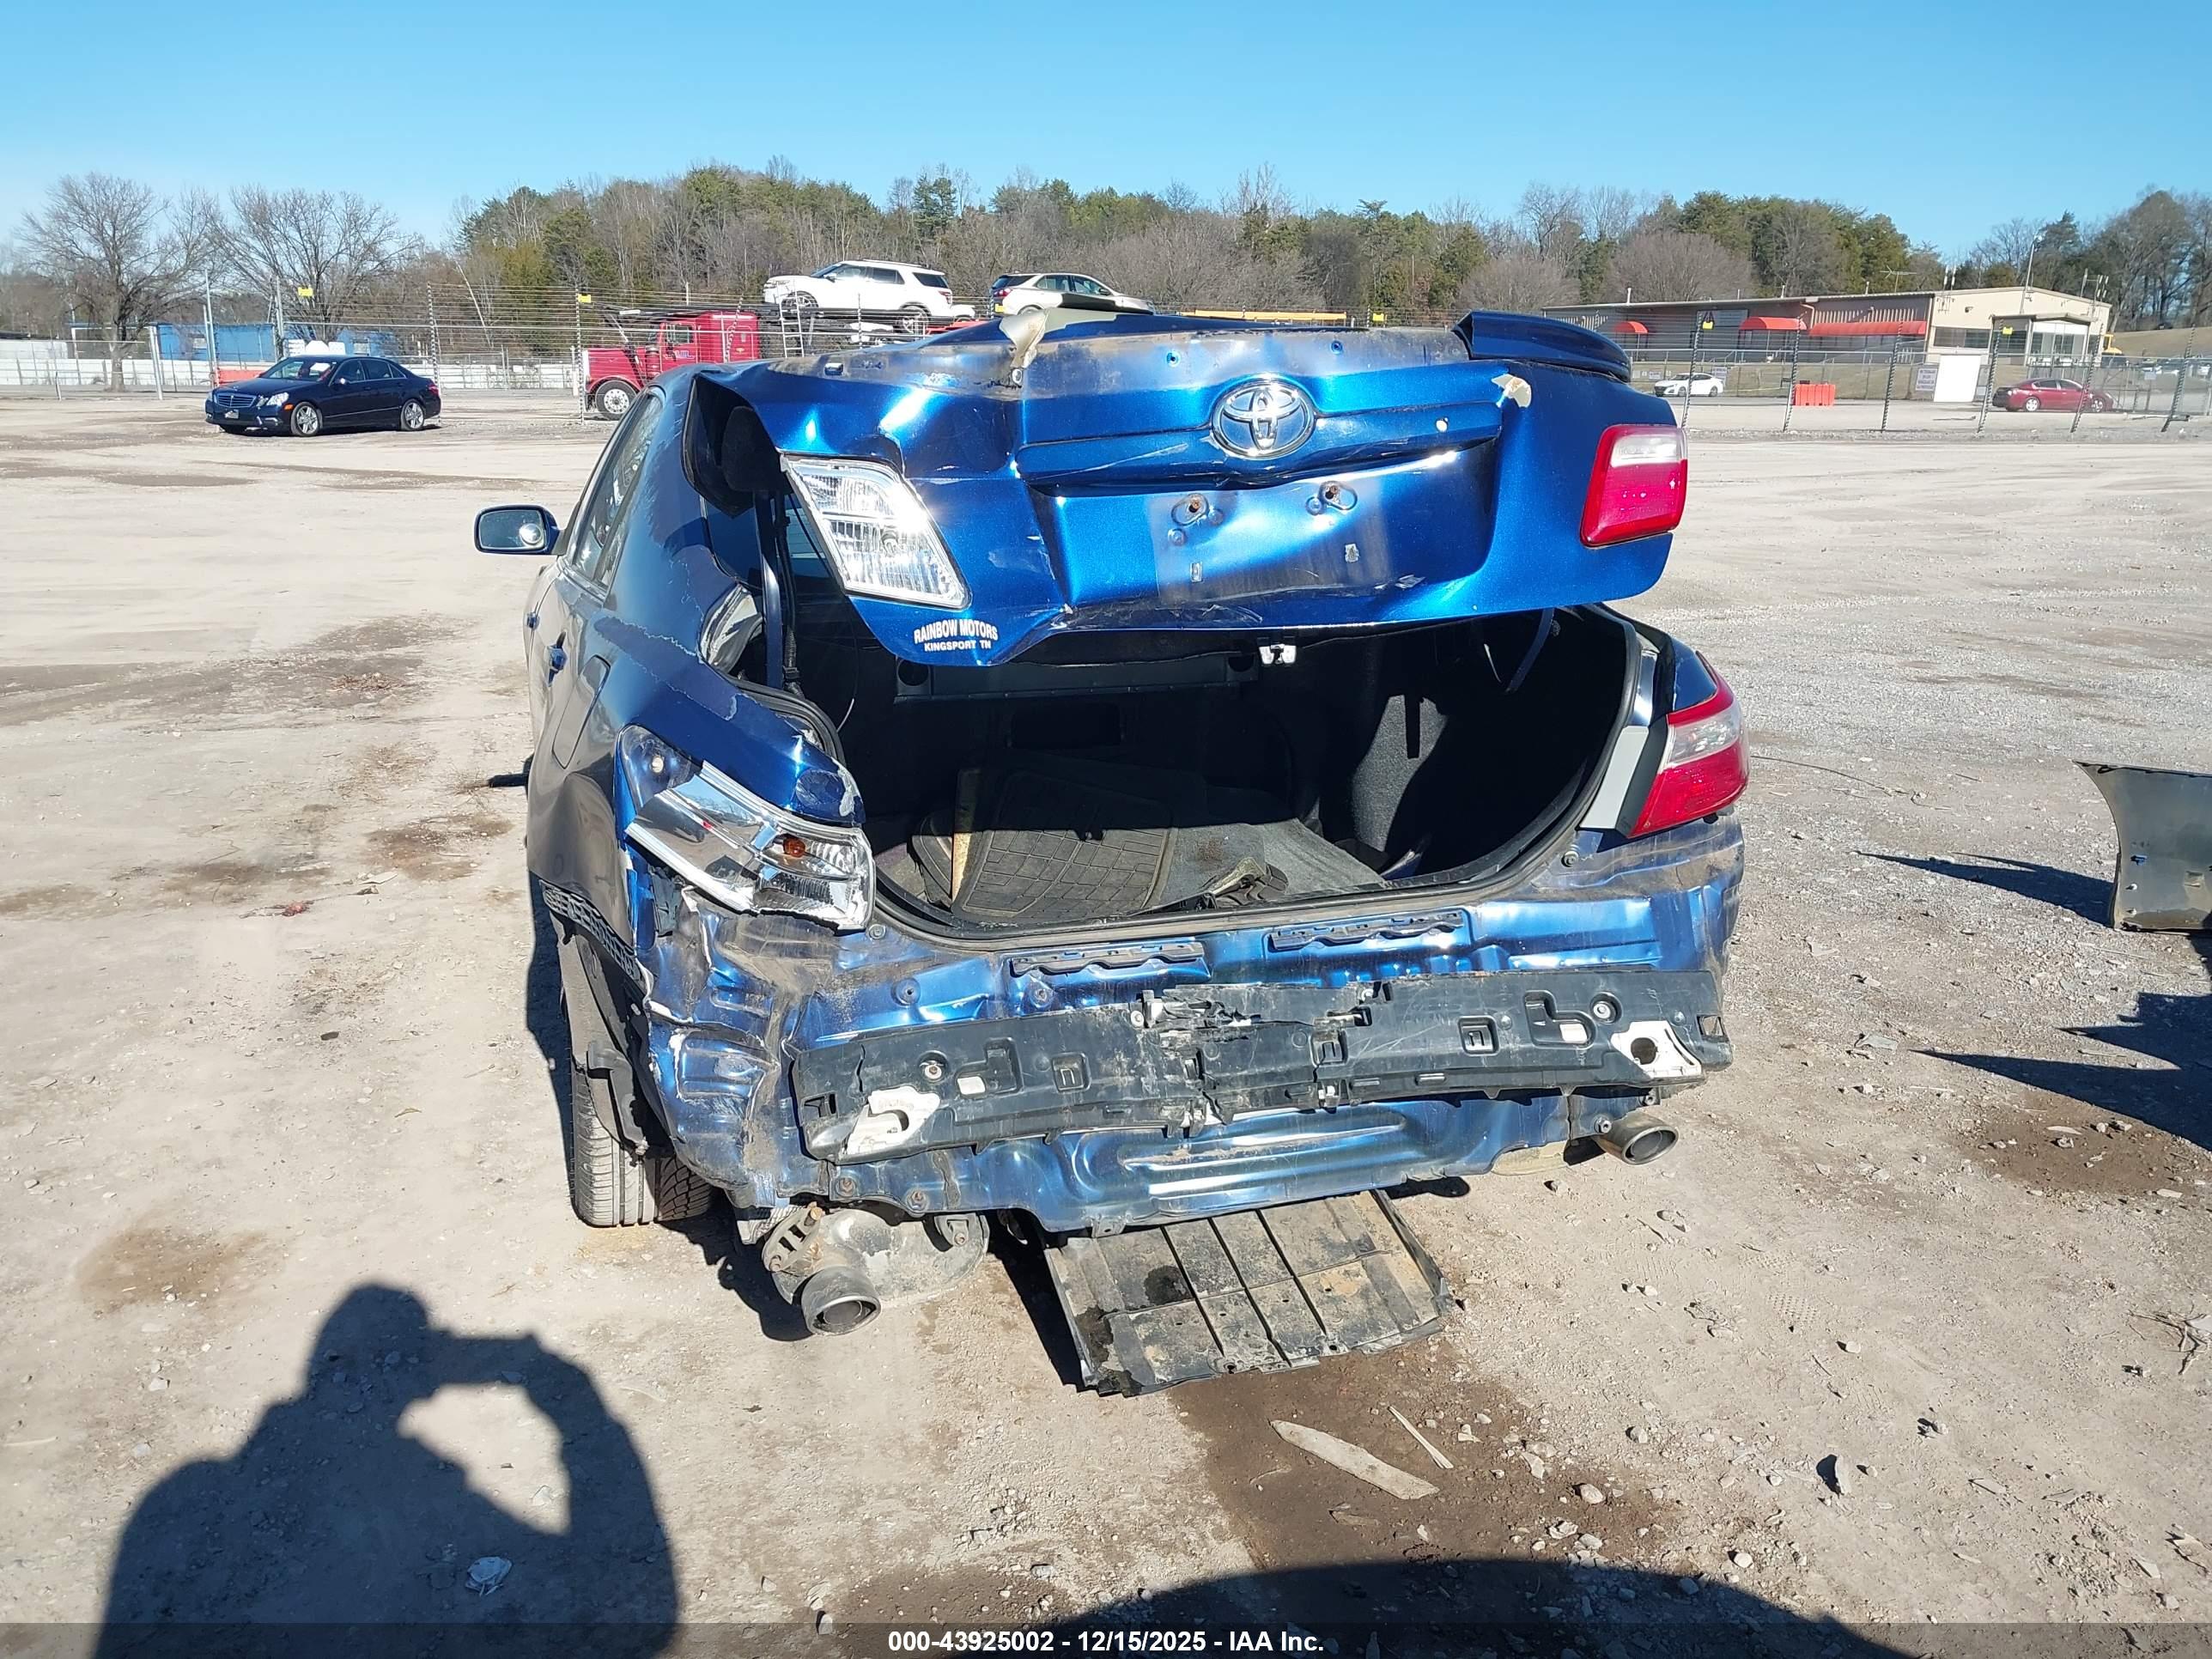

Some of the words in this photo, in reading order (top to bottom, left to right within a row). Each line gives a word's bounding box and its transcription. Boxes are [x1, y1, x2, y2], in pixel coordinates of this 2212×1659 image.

[914, 619, 957, 644] RAINBOW
[959, 618, 999, 641] MOTORS
[924, 640, 977, 652] KINGSPORT
[979, 640, 992, 649] TN
